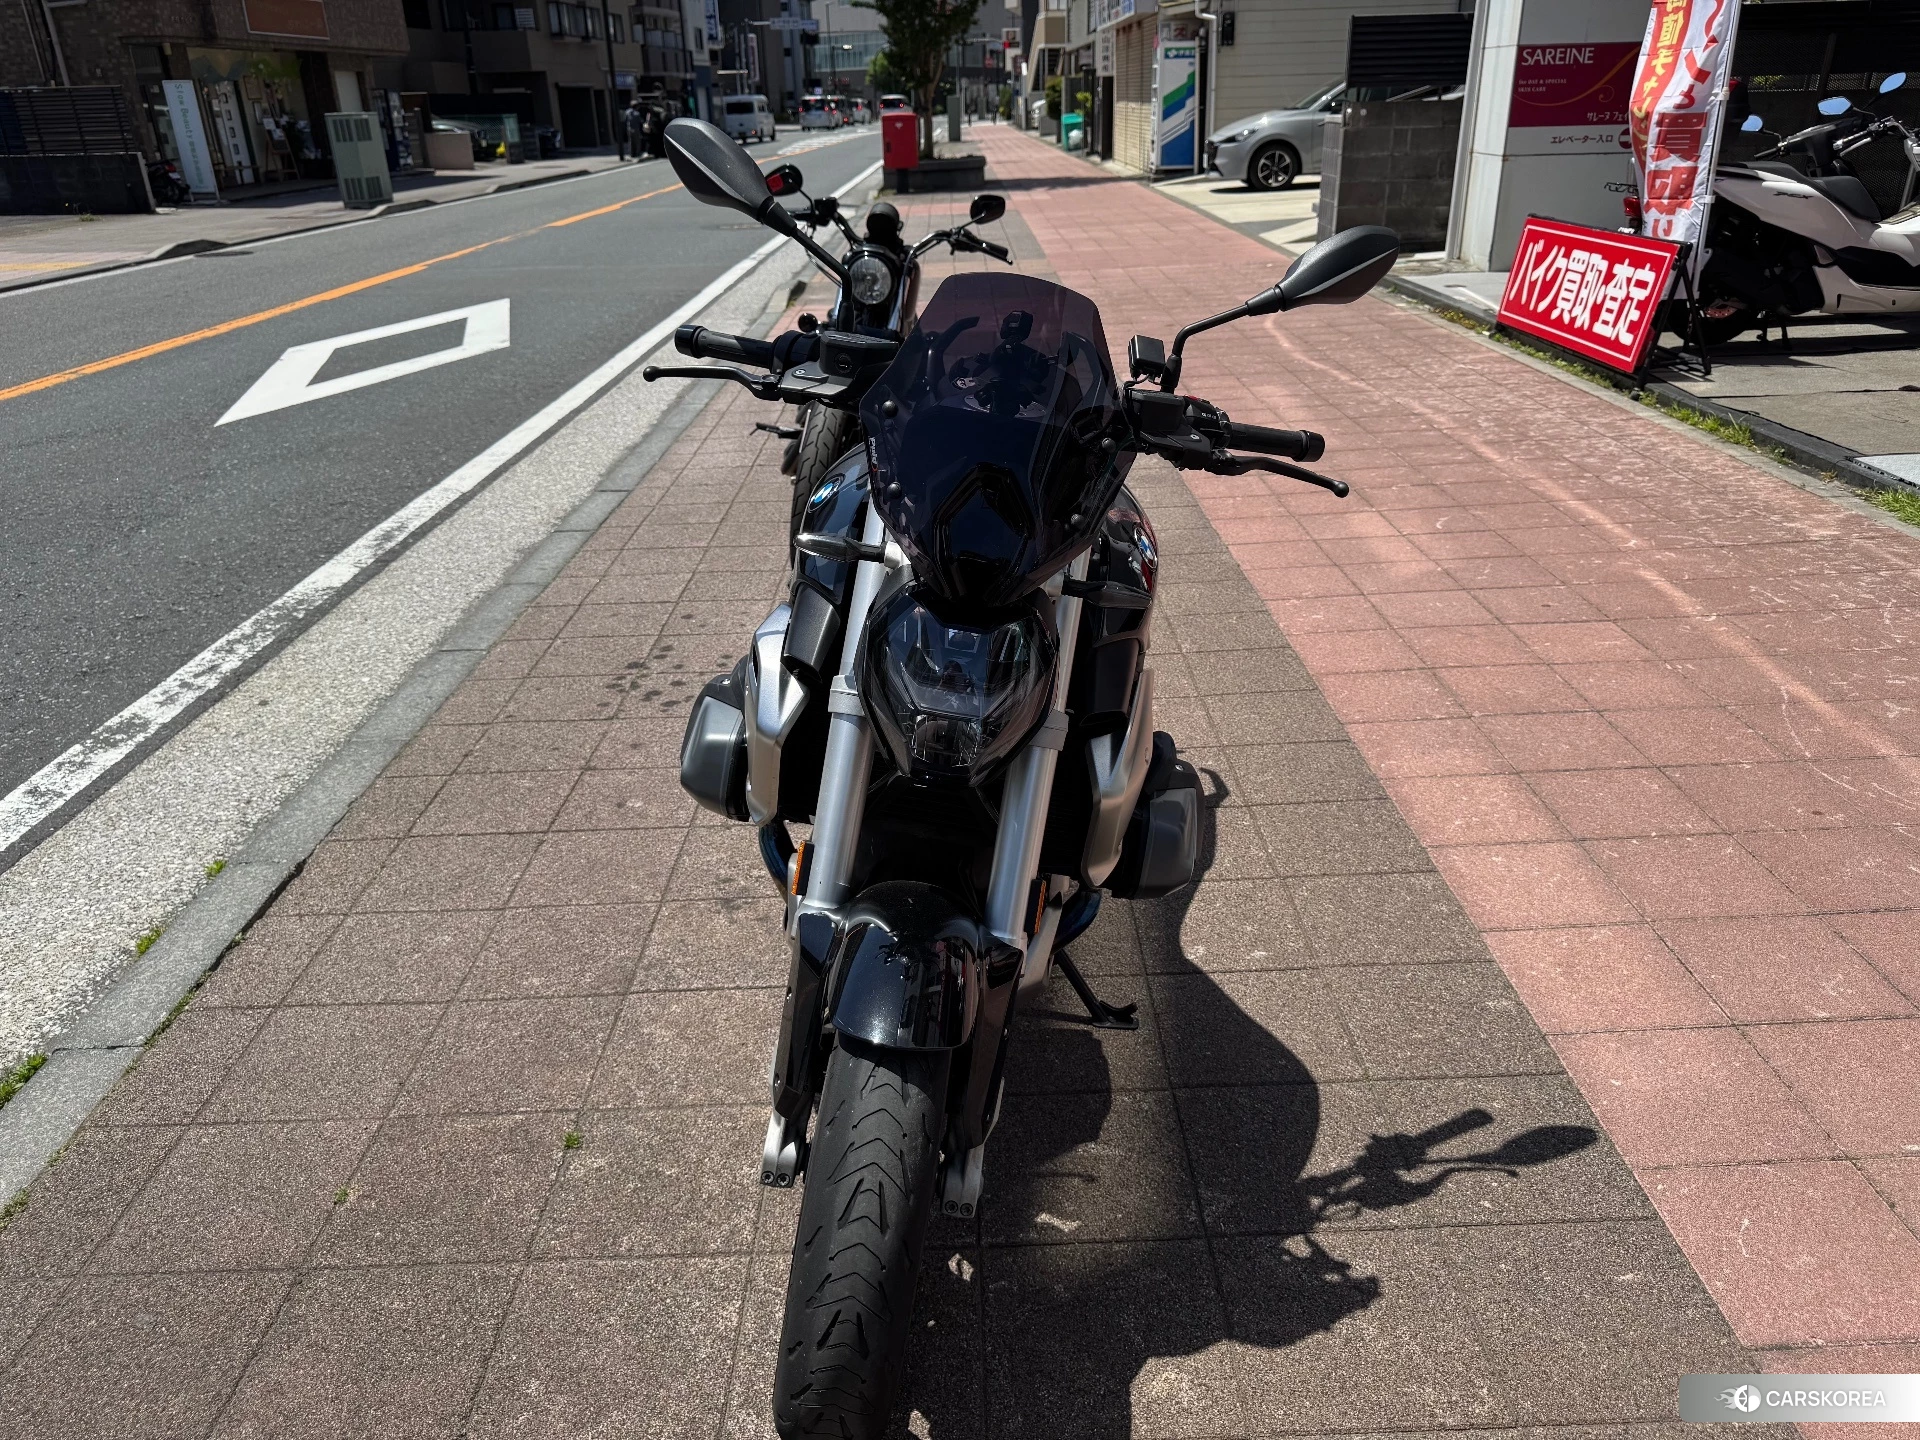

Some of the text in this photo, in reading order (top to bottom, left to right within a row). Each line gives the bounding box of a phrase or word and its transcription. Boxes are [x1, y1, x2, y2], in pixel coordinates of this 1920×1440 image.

[1521, 47, 1595, 66] SAREINE
[1550, 134, 1614, 144] エレベーター入口
